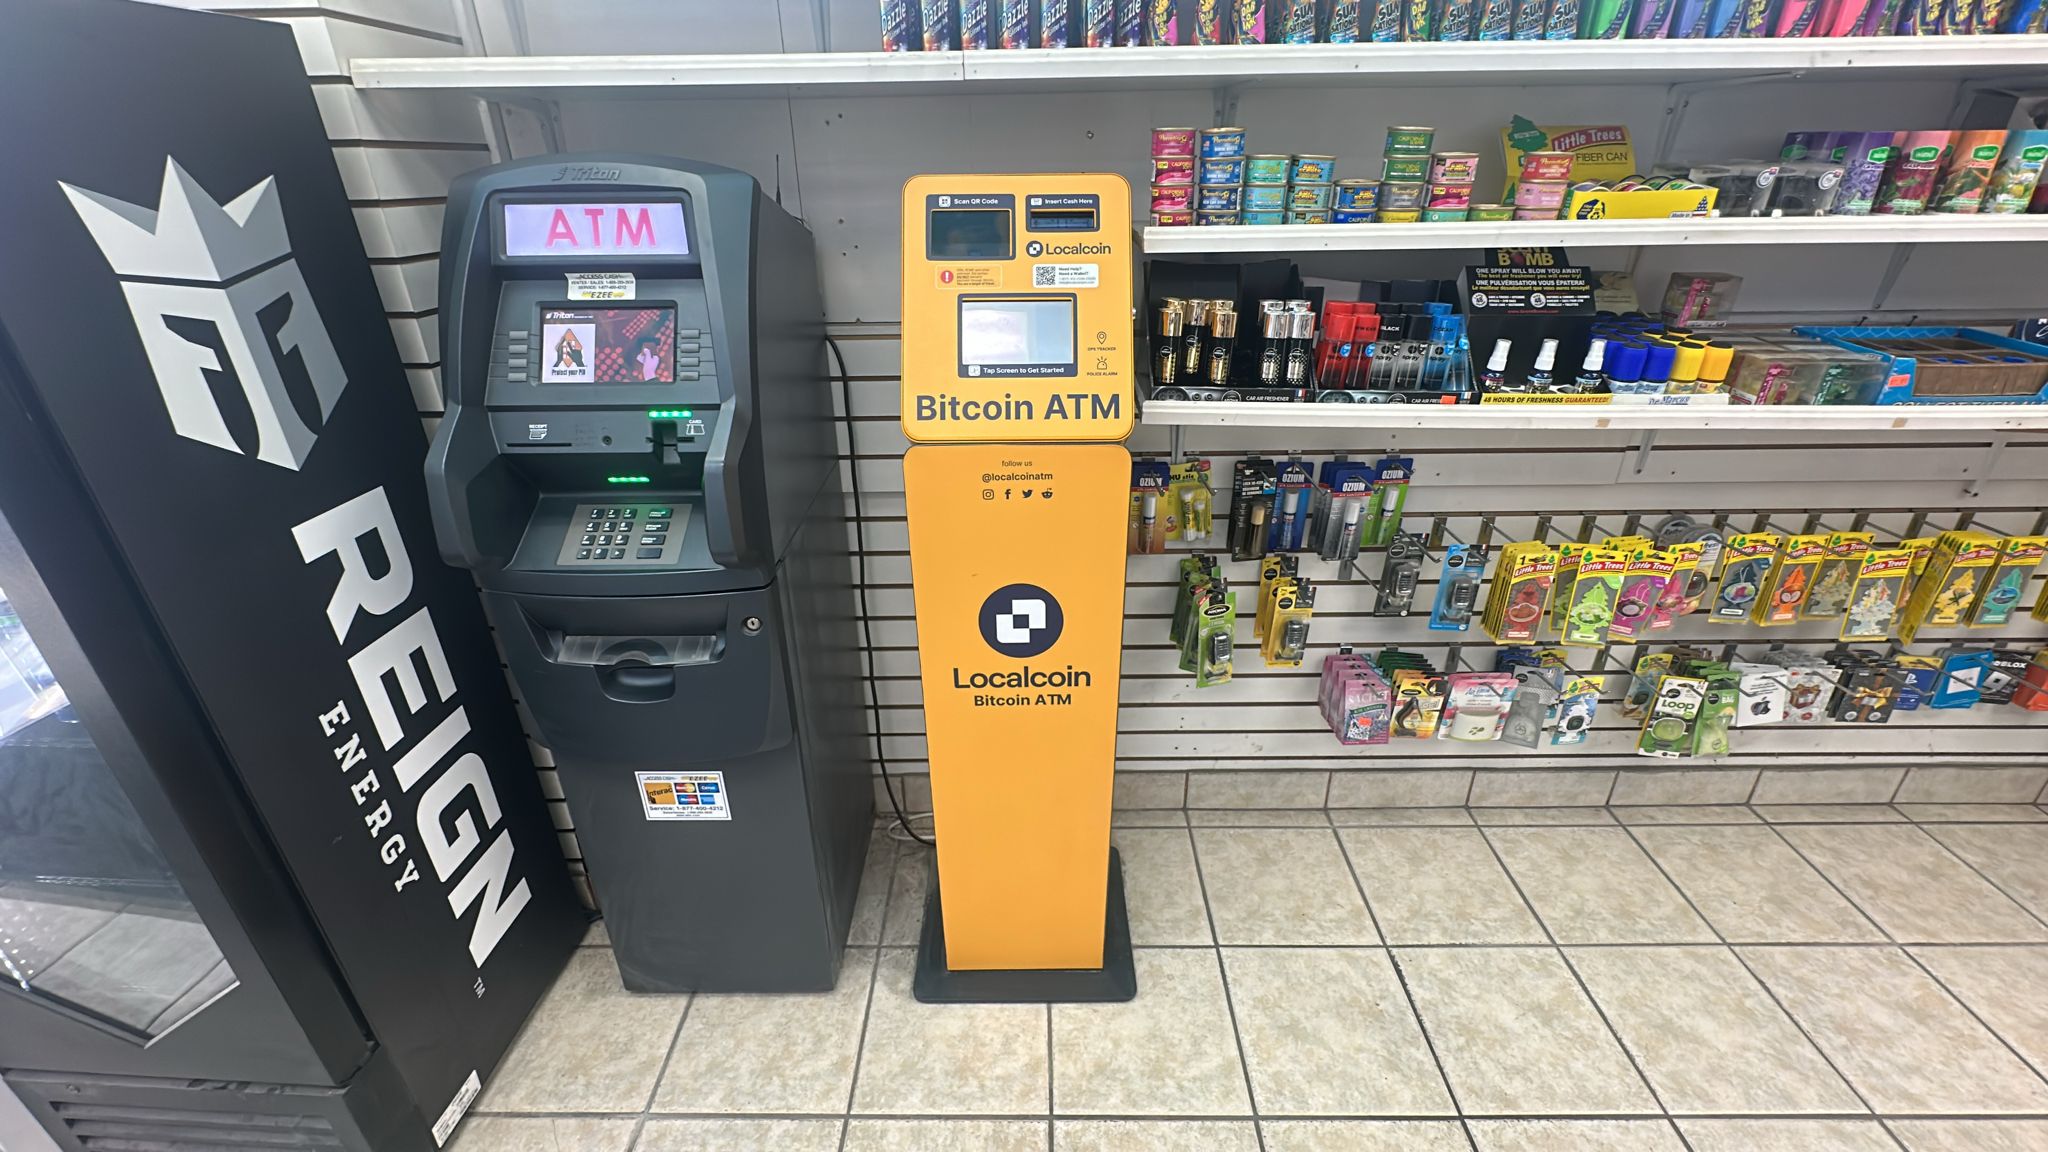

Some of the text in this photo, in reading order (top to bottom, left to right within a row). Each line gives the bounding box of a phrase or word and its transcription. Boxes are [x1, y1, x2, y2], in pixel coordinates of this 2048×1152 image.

[882, 0, 906, 35] Dazzle
[923, 0, 949, 32] Dazzle
[963, 1, 987, 36] Dazzle
[1001, 0, 1028, 31] Dazzle
[1043, 0, 1068, 31] Dazzle
[1089, 0, 1113, 29] Dazzle
[1554, 132, 1586, 152] Little
[1588, 128, 1622, 142] Trees
[1576, 152, 1603, 161] FIBER
[1606, 152, 1628, 161] CAN
[571, 166, 621, 181] Triton
[545, 207, 656, 248] ATM
[1046, 242, 1111, 255] Localcoin
[591, 291, 613, 299] EZEE
[916, 393, 1120, 421] Bitcoin ATM
[982, 472, 1053, 483] @localcoinatm
[1282, 473, 1305, 483] OZIUM
[1382, 470, 1404, 479] OZIUM
[1342, 482, 1366, 492] OZIUM
[1515, 564, 1553, 576] Little Trees
[1581, 561, 1625, 573] Little Trees
[1628, 561, 1673, 571] Little Trees
[1862, 559, 1908, 574] Little Trees
[953, 665, 1091, 689] Localcoin
[974, 693, 1072, 707] Bitcoin ATM
[1662, 699, 1696, 712] Loop
[291, 485, 532, 968] REIGN
[319, 700, 420, 893] ENERGY
